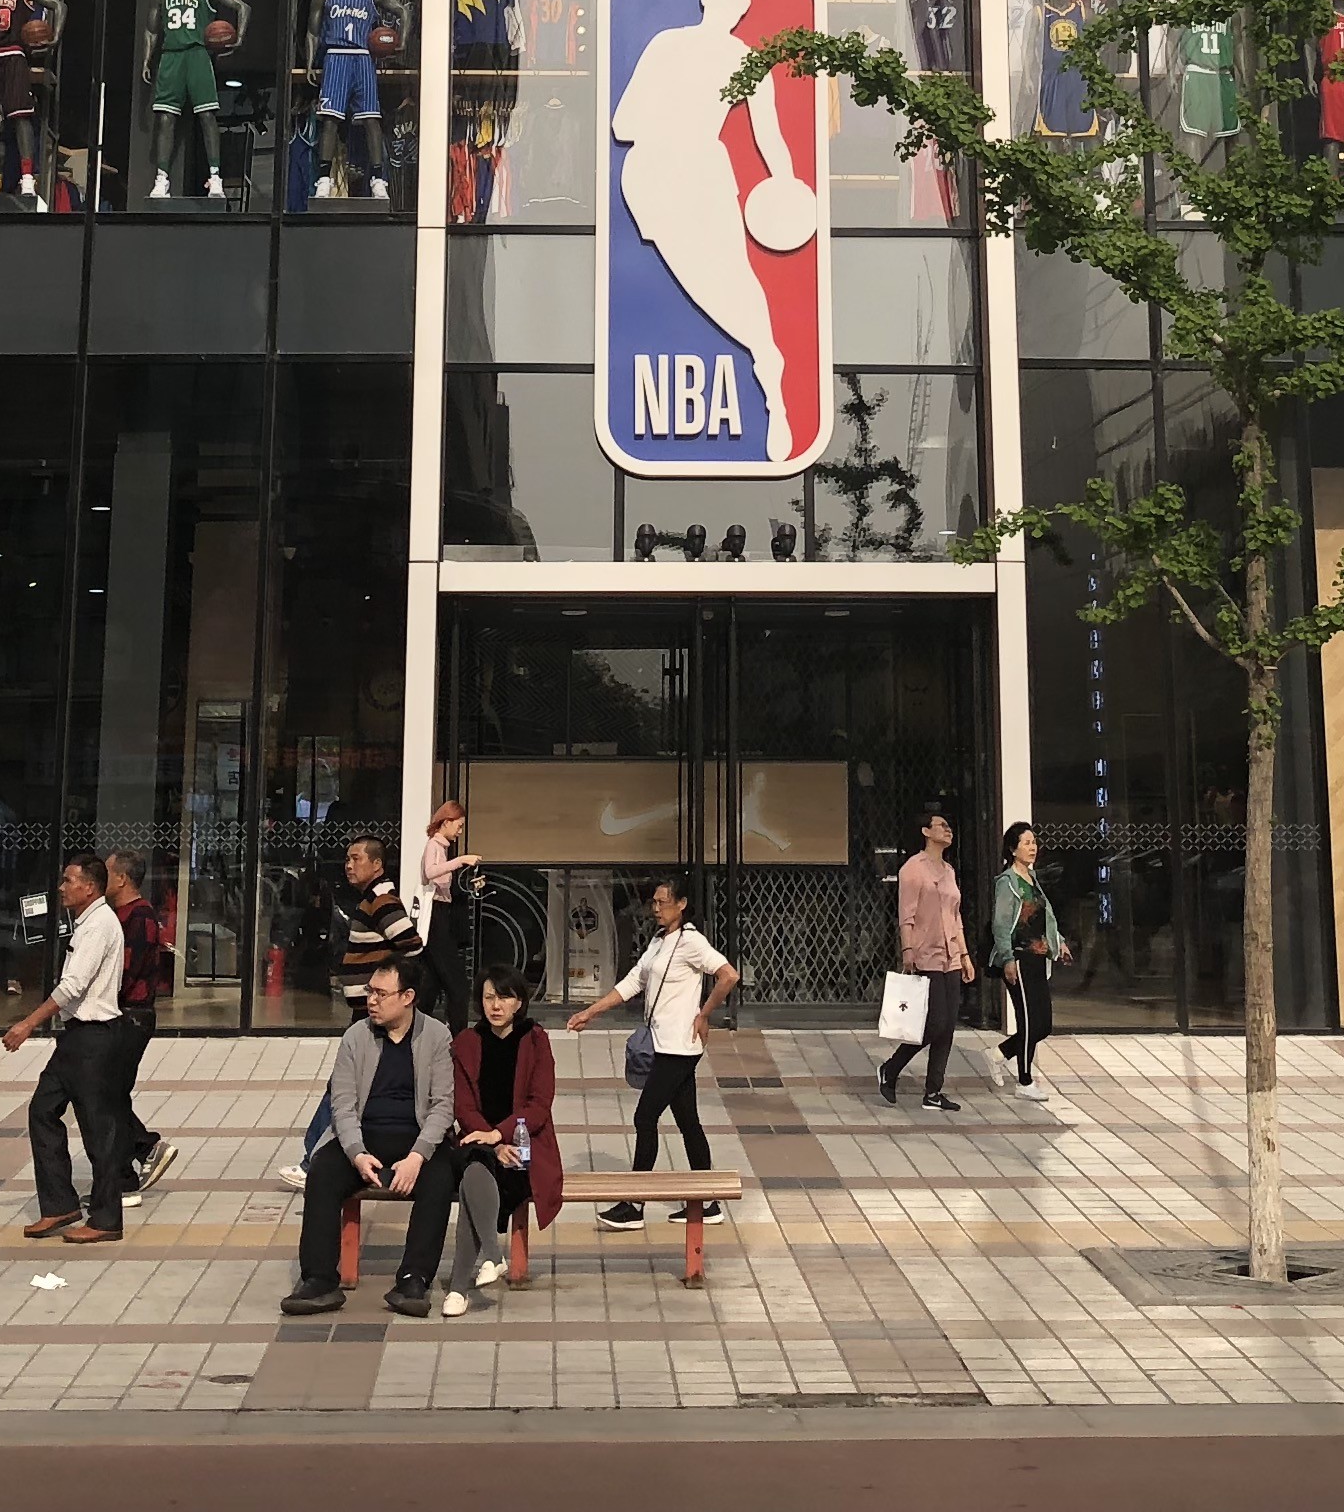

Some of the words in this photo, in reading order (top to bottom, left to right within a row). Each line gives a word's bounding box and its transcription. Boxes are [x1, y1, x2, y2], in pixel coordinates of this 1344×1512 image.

[167, 8, 196, 30] 34
[926, 6, 957, 30] 32
[344, 23, 354, 42] 1
[1200, 33, 1221, 55] 11
[634, 354, 743, 438] NBA
